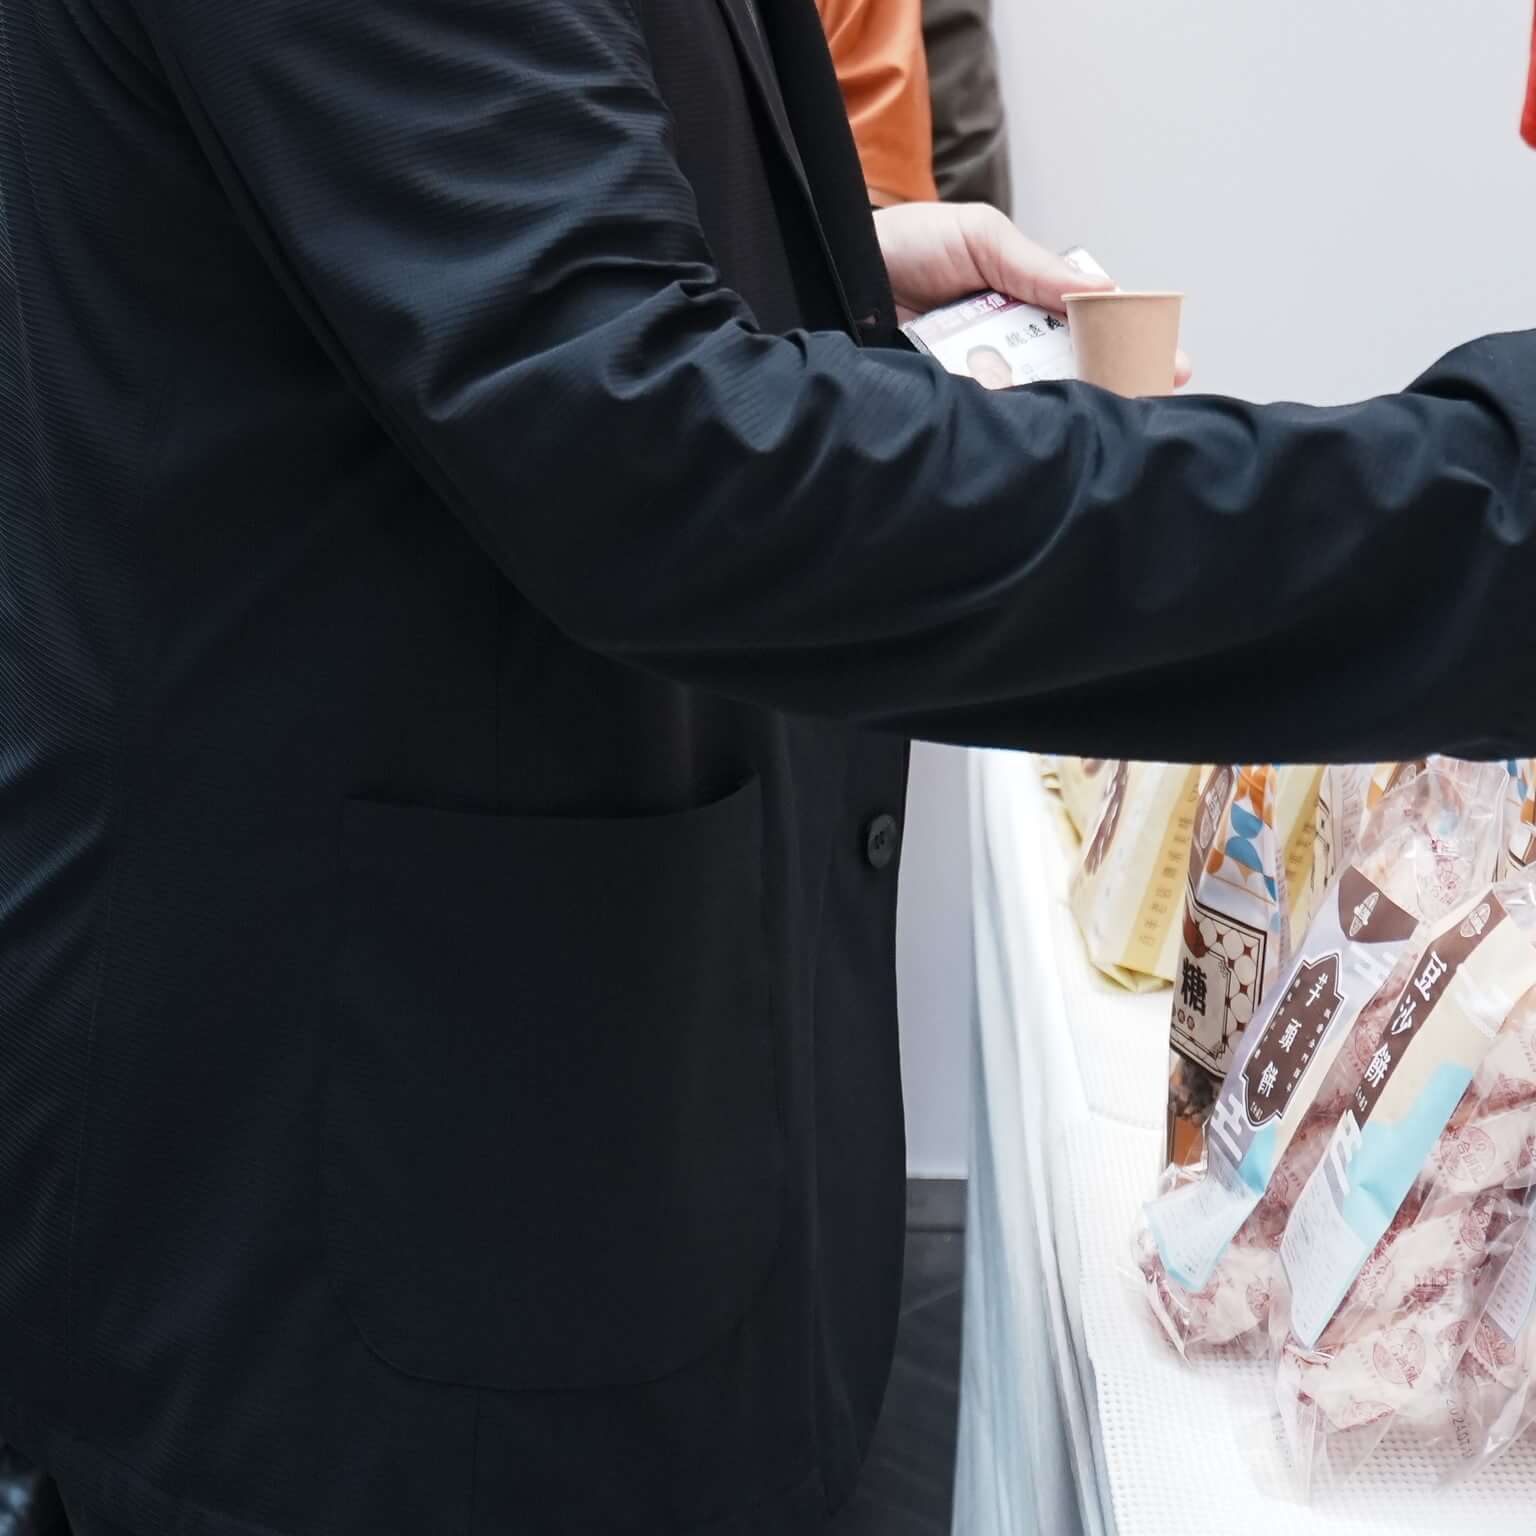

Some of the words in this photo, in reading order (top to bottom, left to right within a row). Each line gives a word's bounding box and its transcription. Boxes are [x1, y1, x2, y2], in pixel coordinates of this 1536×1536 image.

[1260, 972, 1330, 1099] 芋頭餅
[1364, 950, 1449, 1088] 豆沙餅
